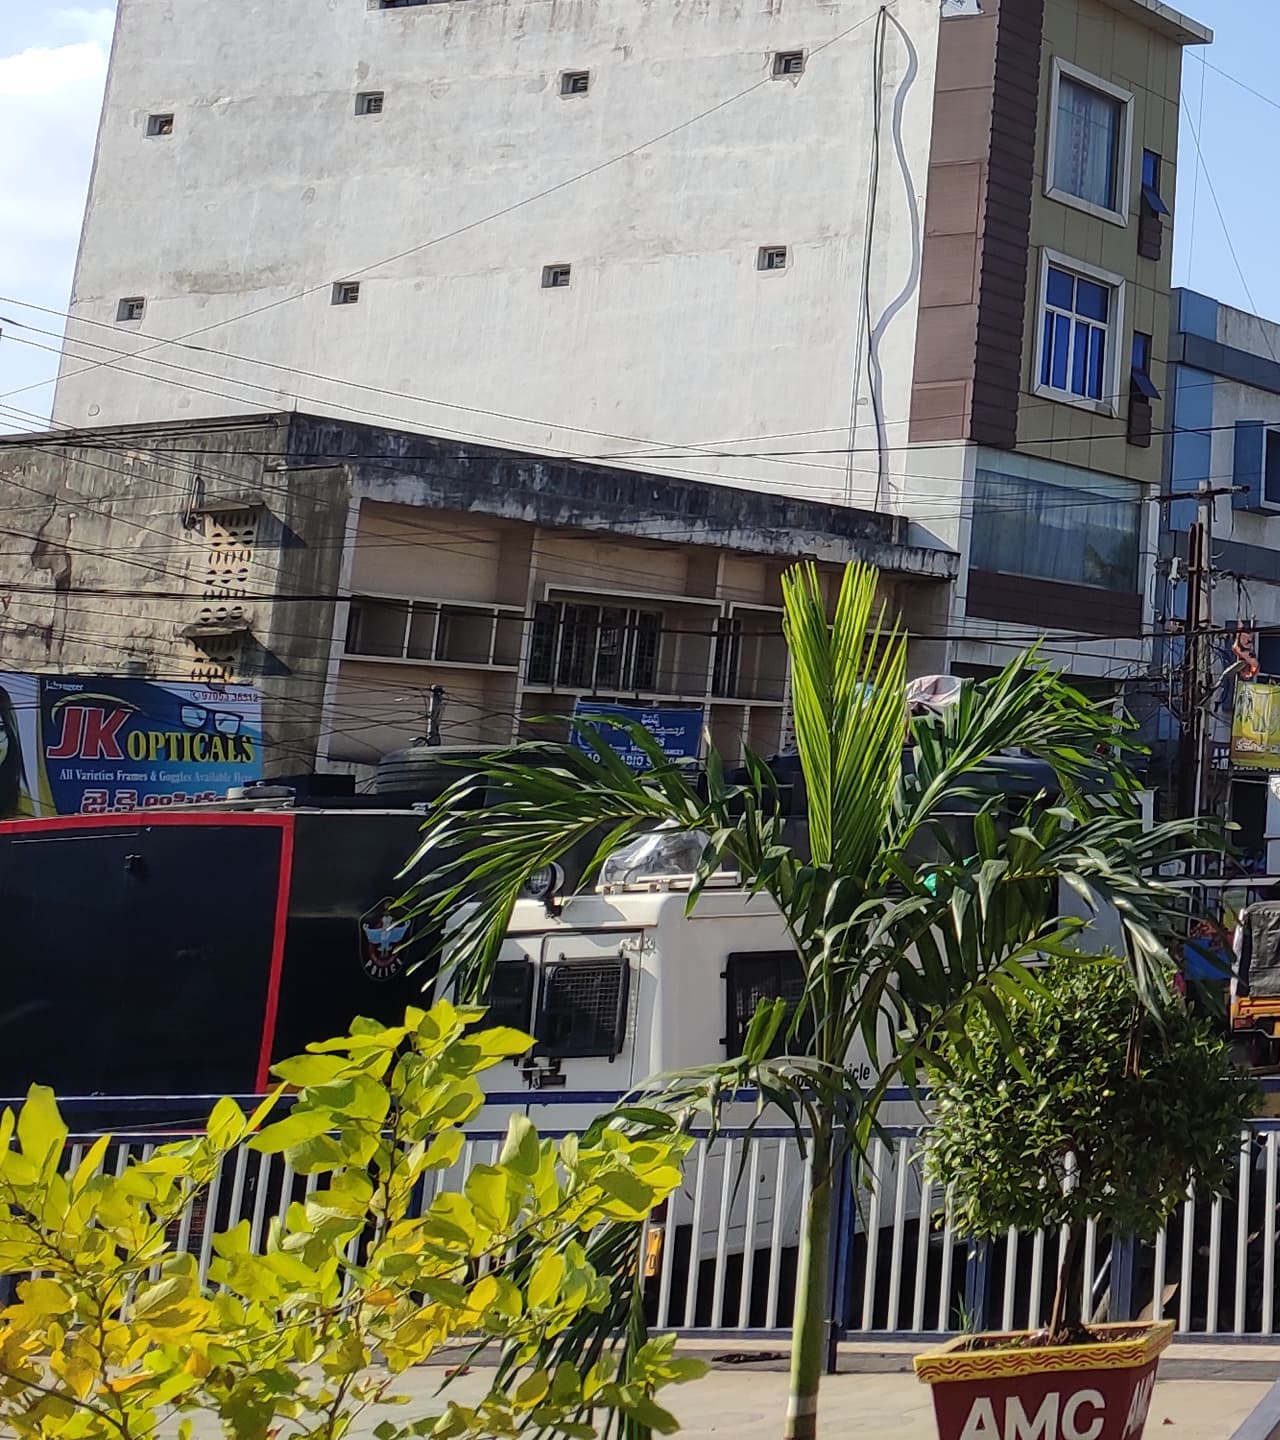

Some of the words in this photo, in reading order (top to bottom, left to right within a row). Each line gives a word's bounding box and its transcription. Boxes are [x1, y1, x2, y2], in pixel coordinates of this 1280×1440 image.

[47, 706, 133, 759] JK
[127, 730, 257, 764] OPTICALS
[59, 768, 73, 781] All
[75, 768, 114, 781] Varieties
[116, 769, 148, 781] Frames
[150, 770, 157, 781] &
[960, 1389, 1106, 1440] AMC
